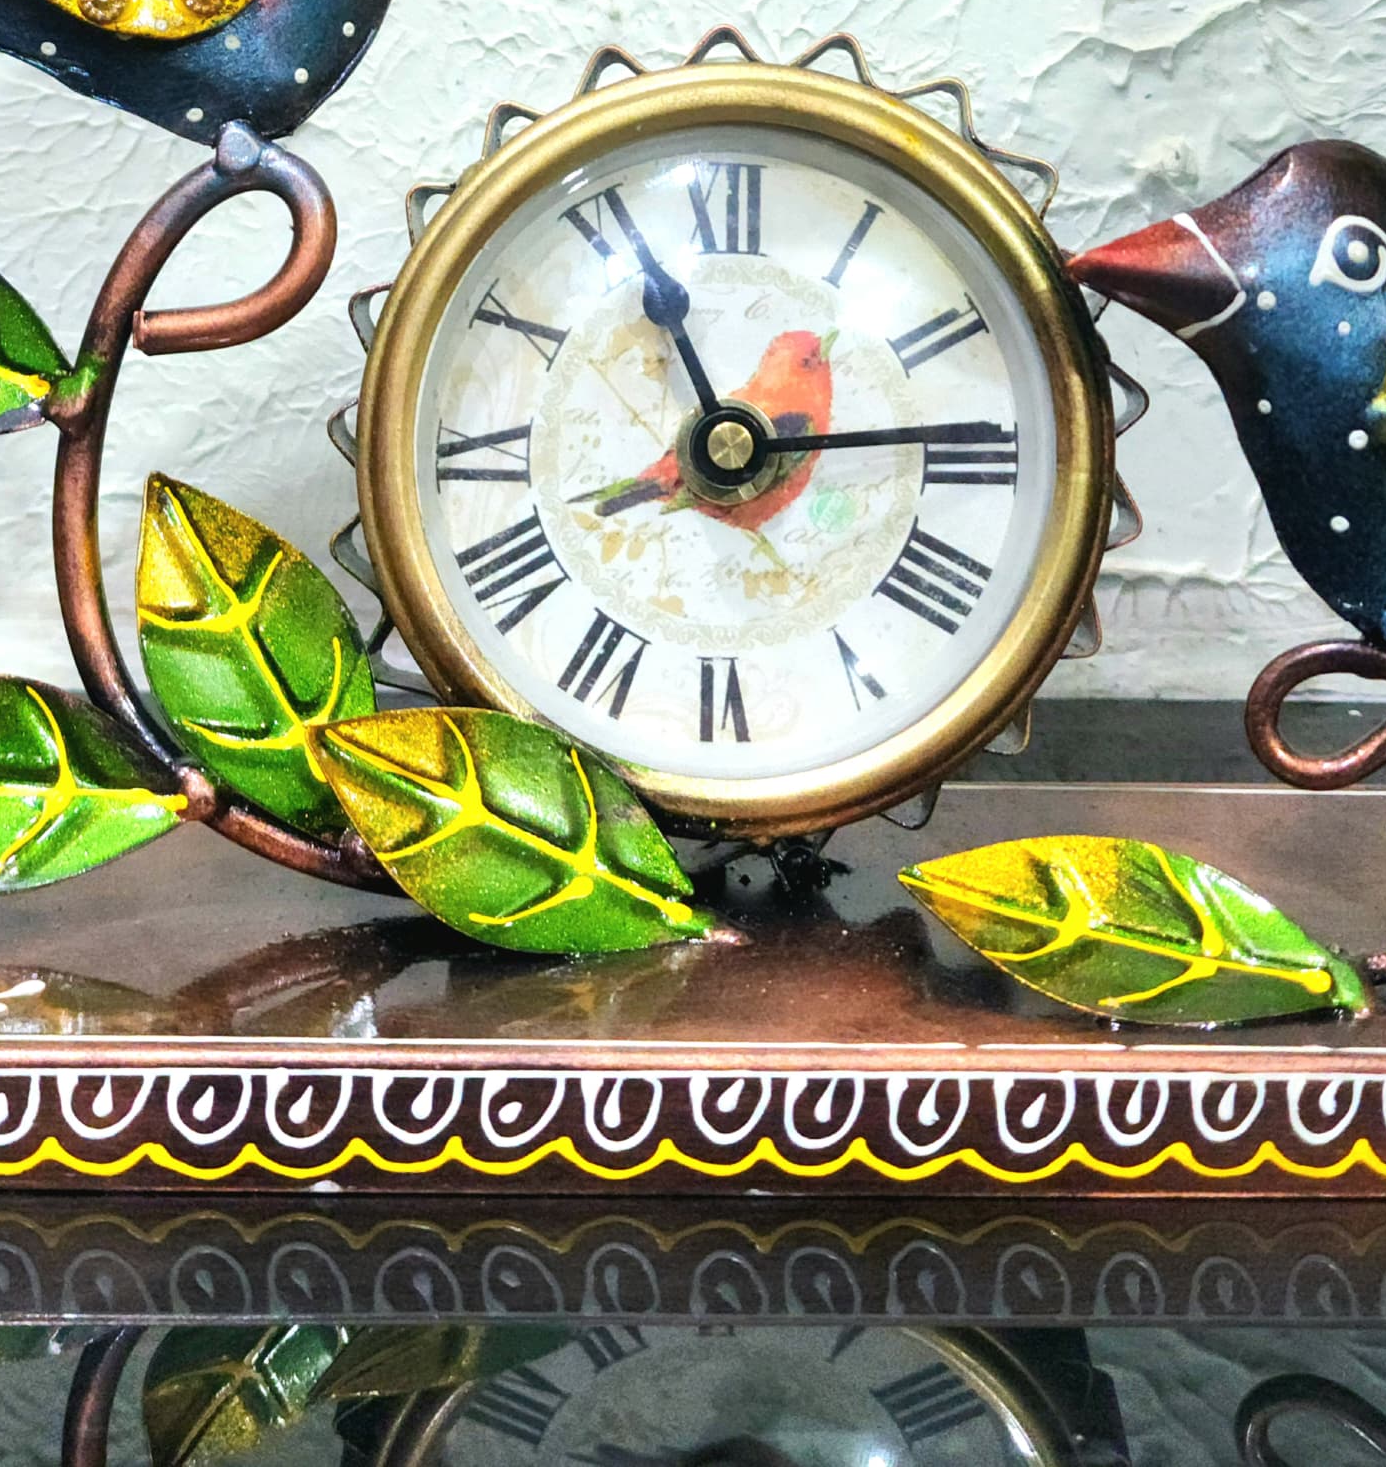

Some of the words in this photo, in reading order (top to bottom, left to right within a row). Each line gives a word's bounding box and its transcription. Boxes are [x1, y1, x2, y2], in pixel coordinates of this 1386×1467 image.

[687, 162, 767, 256] XII
[469, 278, 572, 372] X
[886, 292, 989, 379] II
[435, 418, 533, 494] IX
[453, 504, 572, 636] VIII
[872, 516, 993, 635] IIII
[557, 607, 652, 720] VII
[697, 656, 751, 742] VI
[828, 626, 887, 711] V
